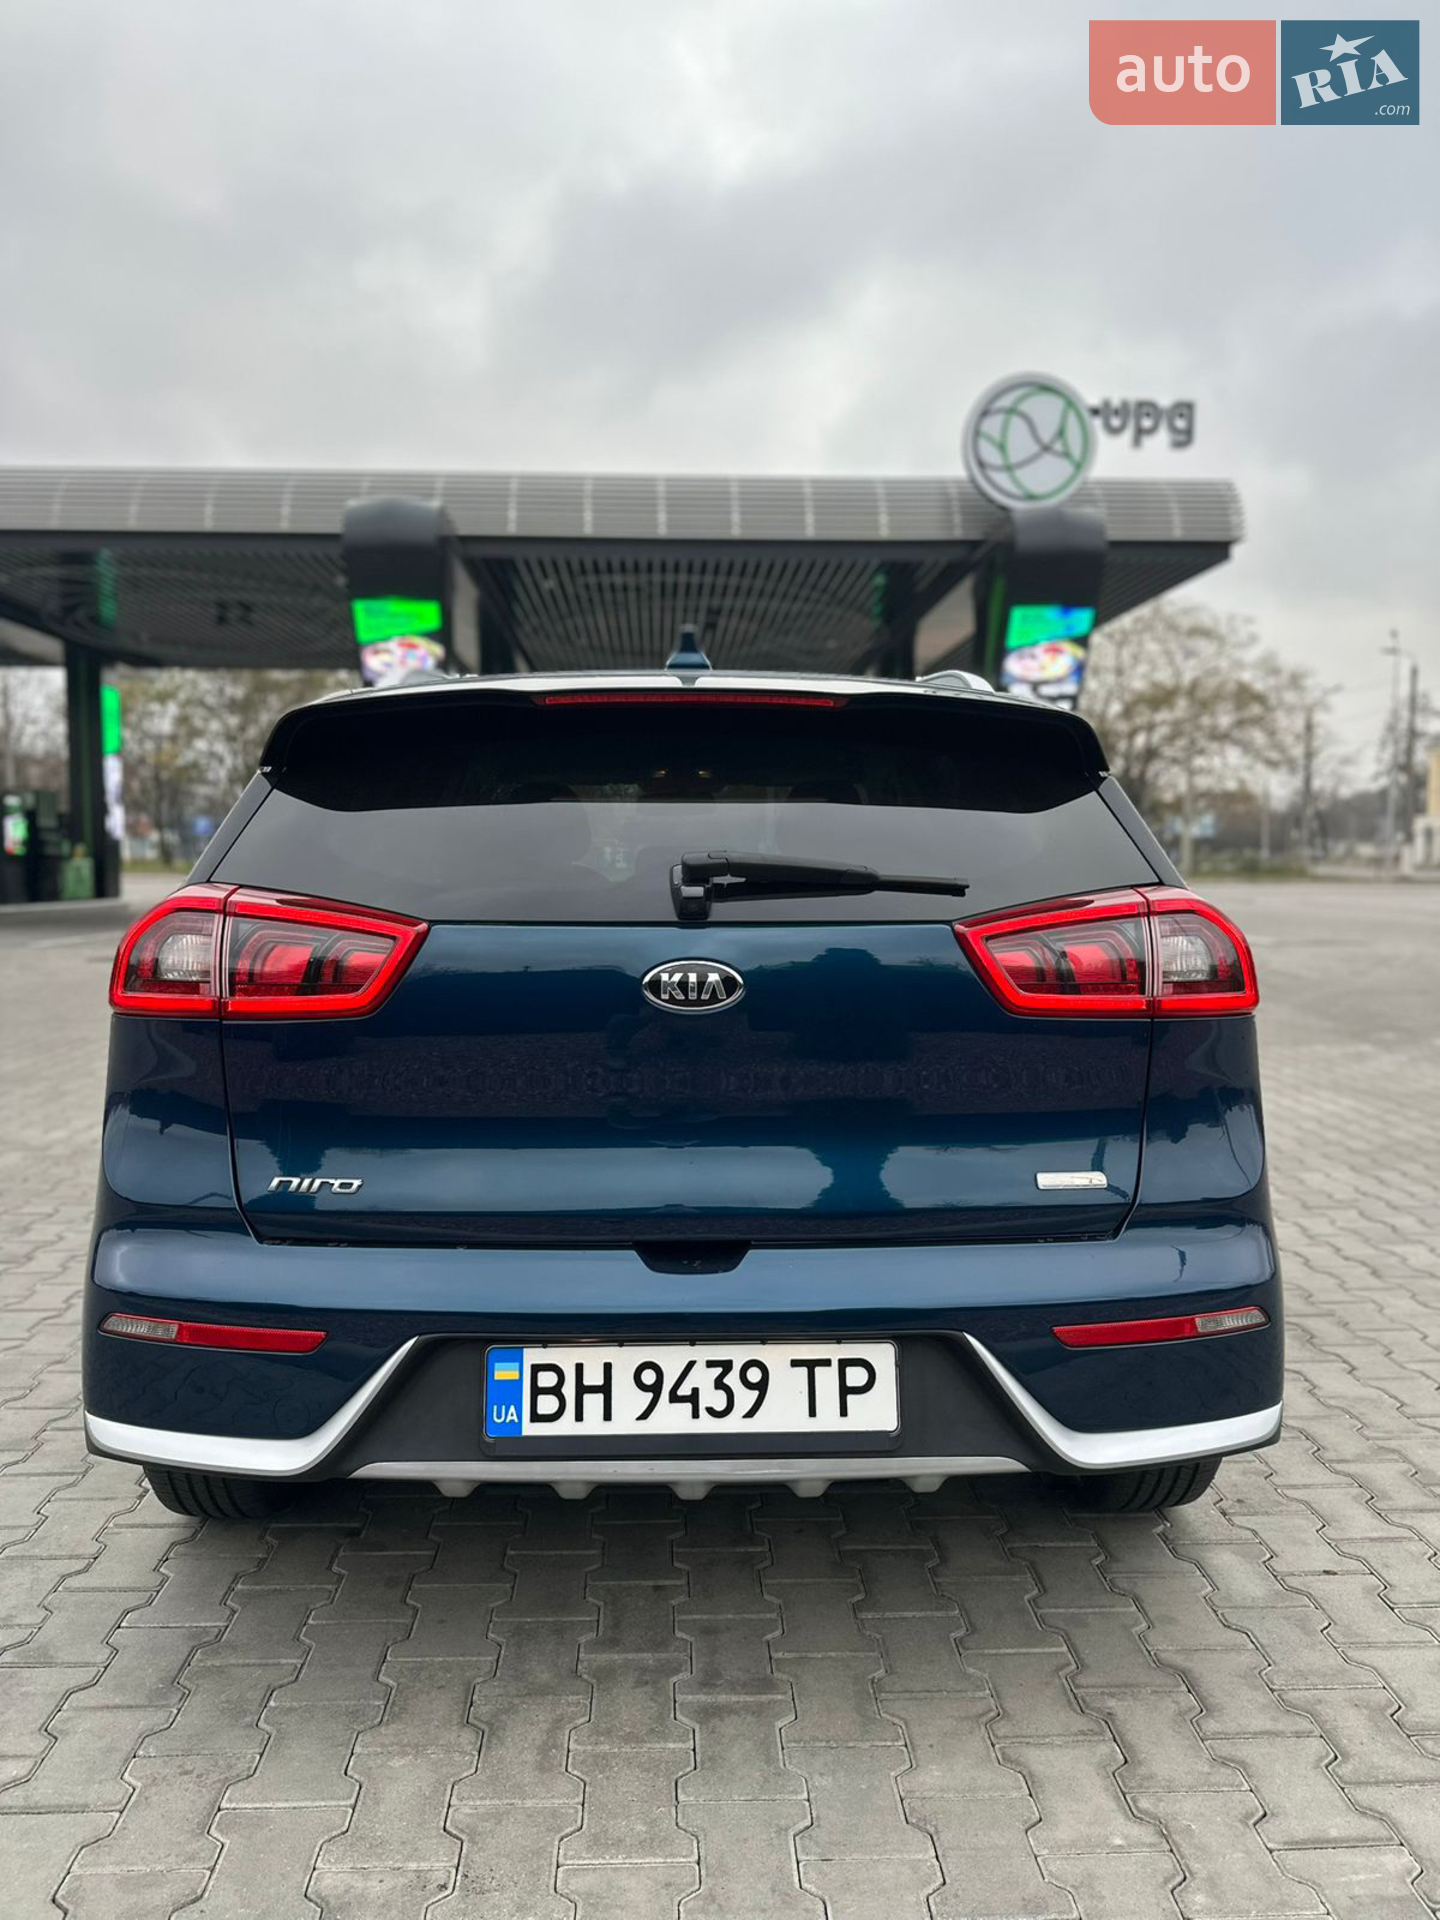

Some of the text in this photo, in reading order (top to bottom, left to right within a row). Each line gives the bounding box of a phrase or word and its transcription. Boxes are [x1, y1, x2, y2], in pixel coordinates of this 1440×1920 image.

[1102, 400, 1196, 450] upg
[660, 972, 727, 1000] KIA
[529, 1357, 877, 1423] BH 9439 TP
[492, 1405, 519, 1424] UA
